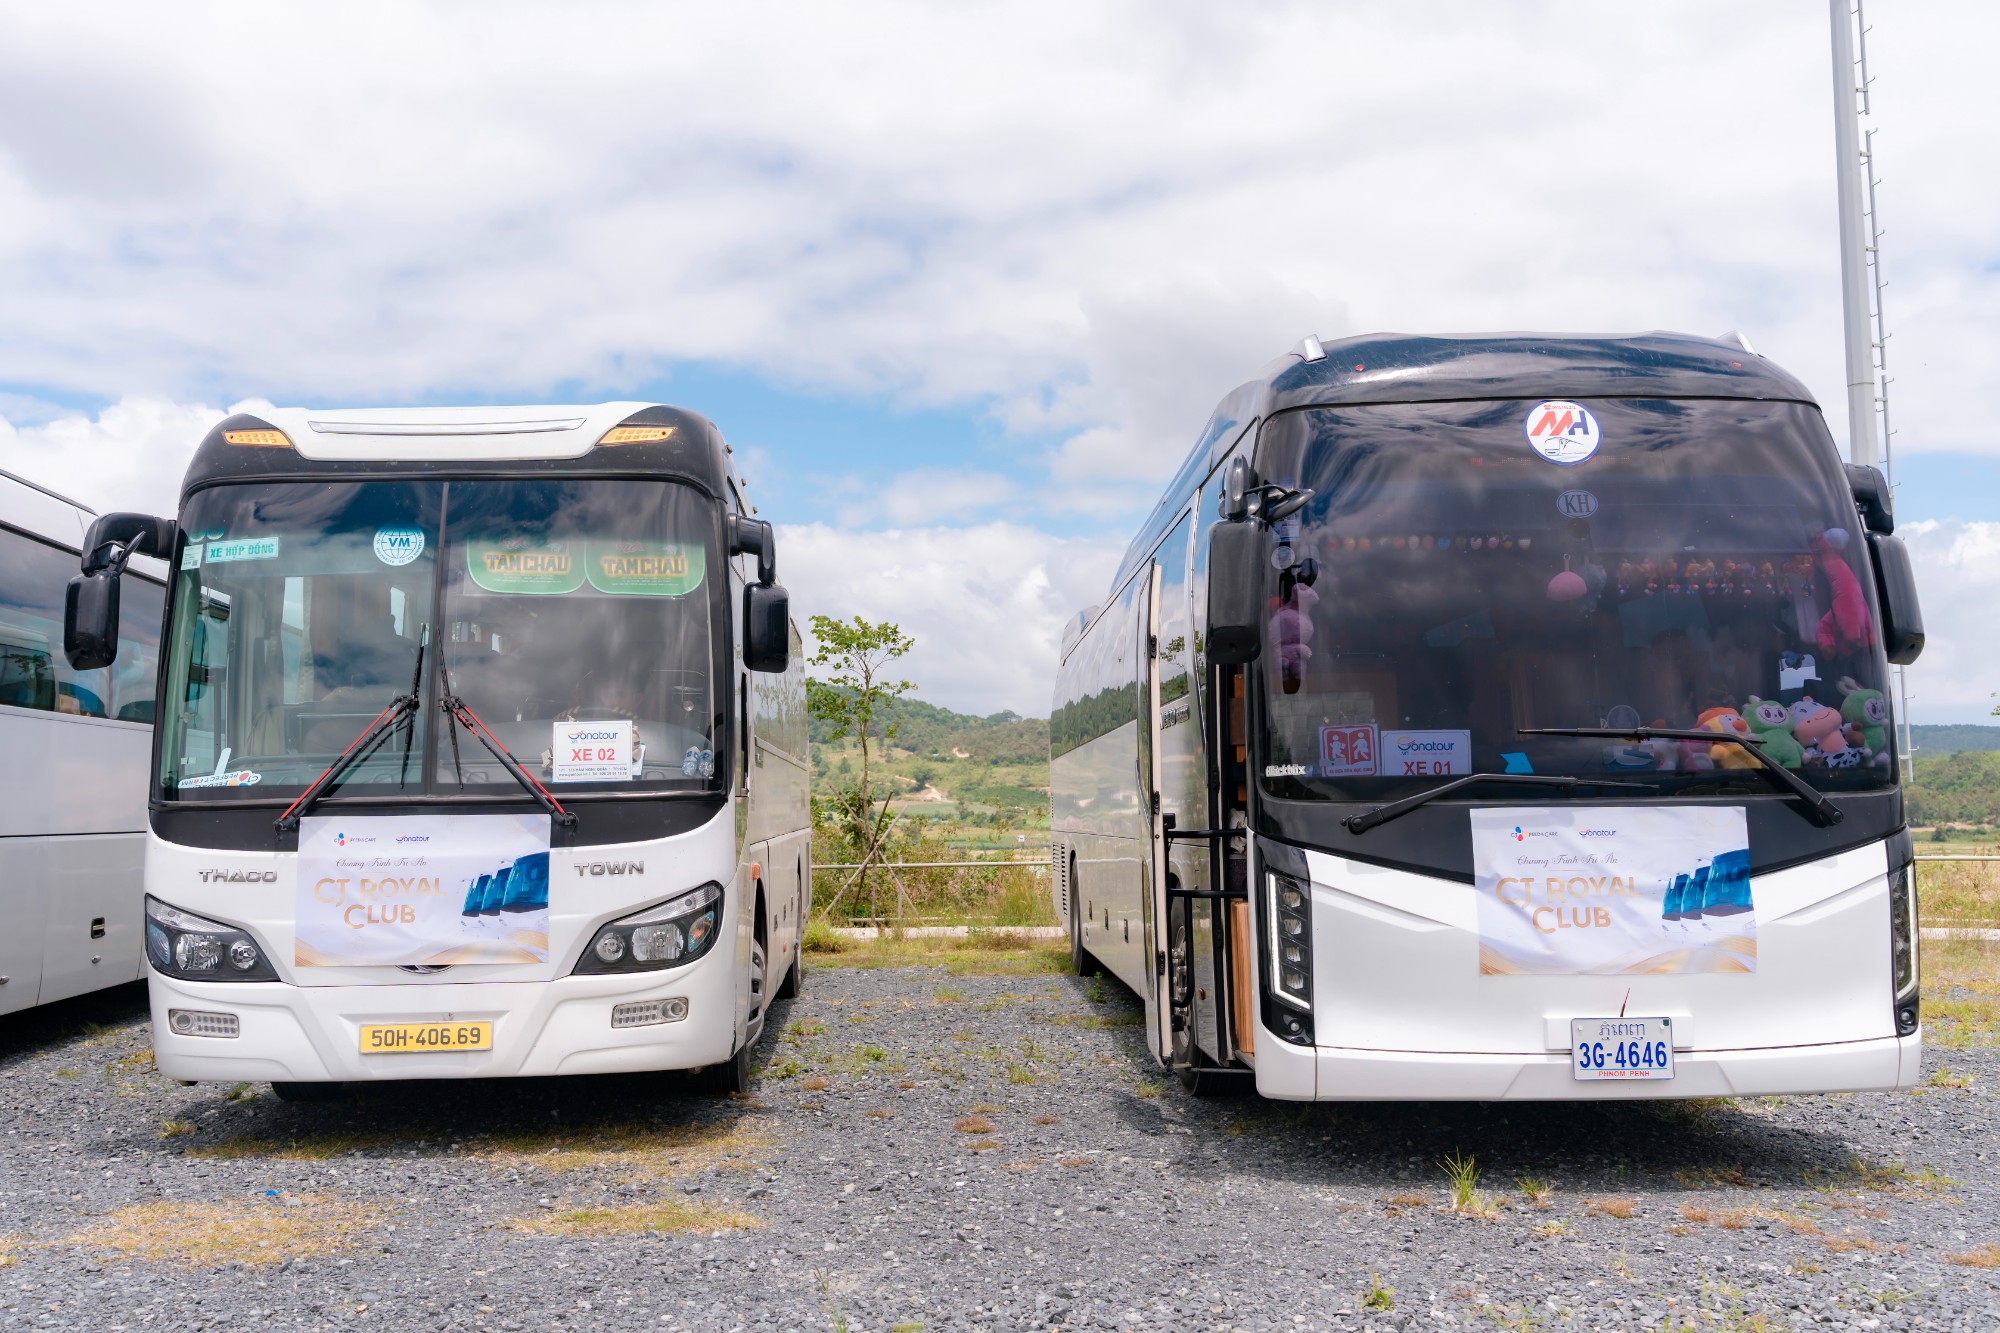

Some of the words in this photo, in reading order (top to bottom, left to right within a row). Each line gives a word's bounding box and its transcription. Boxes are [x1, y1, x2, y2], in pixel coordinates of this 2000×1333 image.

[1564, 494, 1591, 513] KH
[210, 547, 223, 559] XE
[226, 544, 245, 558] HỢP
[388, 537, 410, 547] VM
[571, 748, 592, 761] XE
[598, 748, 615, 761] 02
[1404, 761, 1427, 775] XE
[1433, 760, 1451, 775] 01
[198, 868, 278, 882] THACO
[574, 860, 645, 877] TOWN
[314, 877, 351, 908] CJ
[359, 876, 447, 903] ROYAL
[1496, 877, 1535, 909] CJ
[1546, 876, 1643, 904] ROYAL
[343, 903, 416, 930] CLUB
[1532, 905, 1611, 934] CLUB
[371, 1026, 481, 1048] 50H-406.69
[1579, 1041, 1667, 1069] 3G-4646
